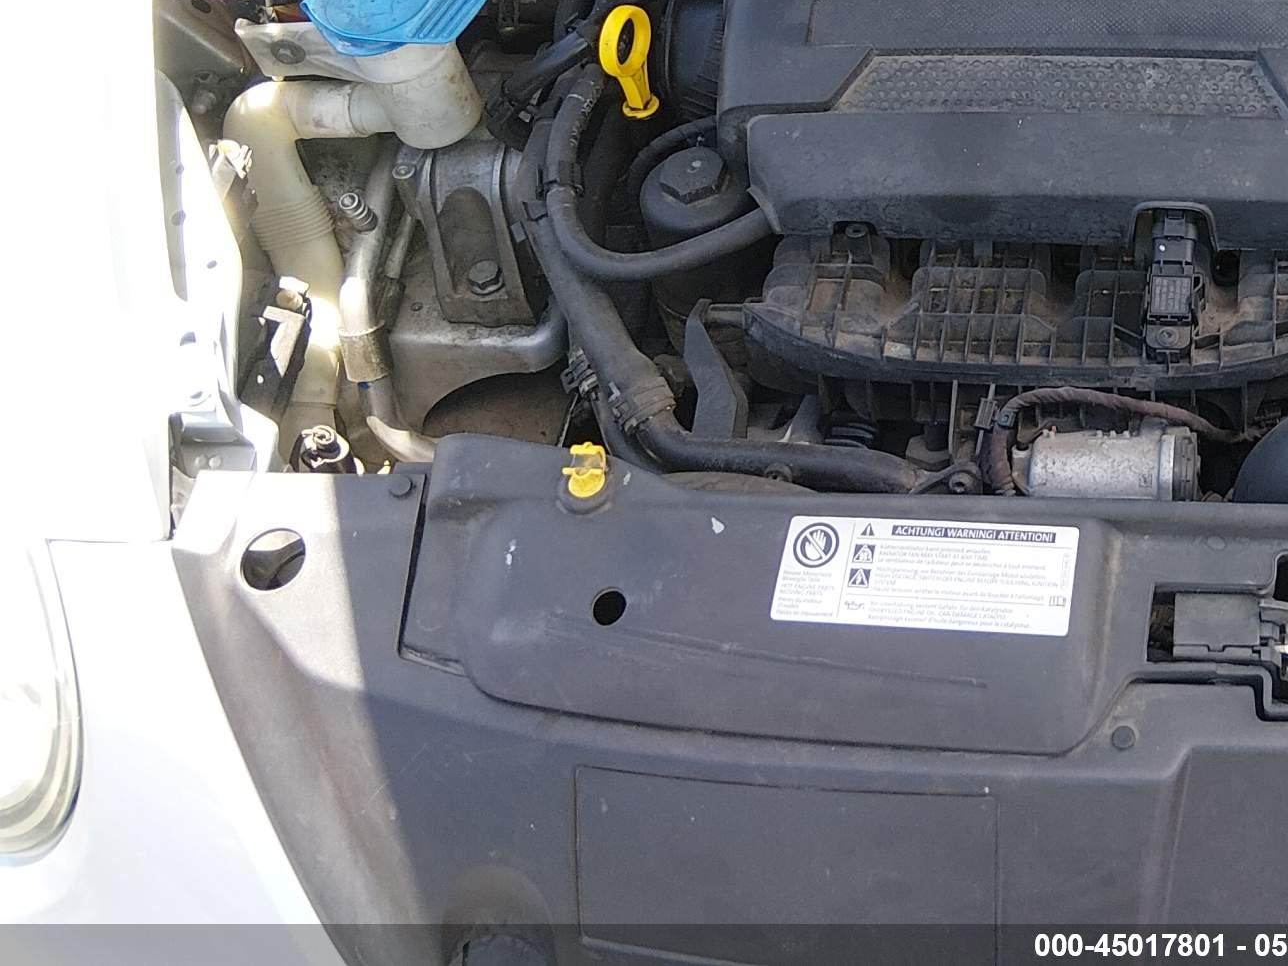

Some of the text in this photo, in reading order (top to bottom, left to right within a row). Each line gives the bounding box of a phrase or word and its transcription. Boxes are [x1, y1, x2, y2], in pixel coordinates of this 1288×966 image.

[895, 526, 1054, 542] ACHTUNG! WARNING! ATTENTION!
